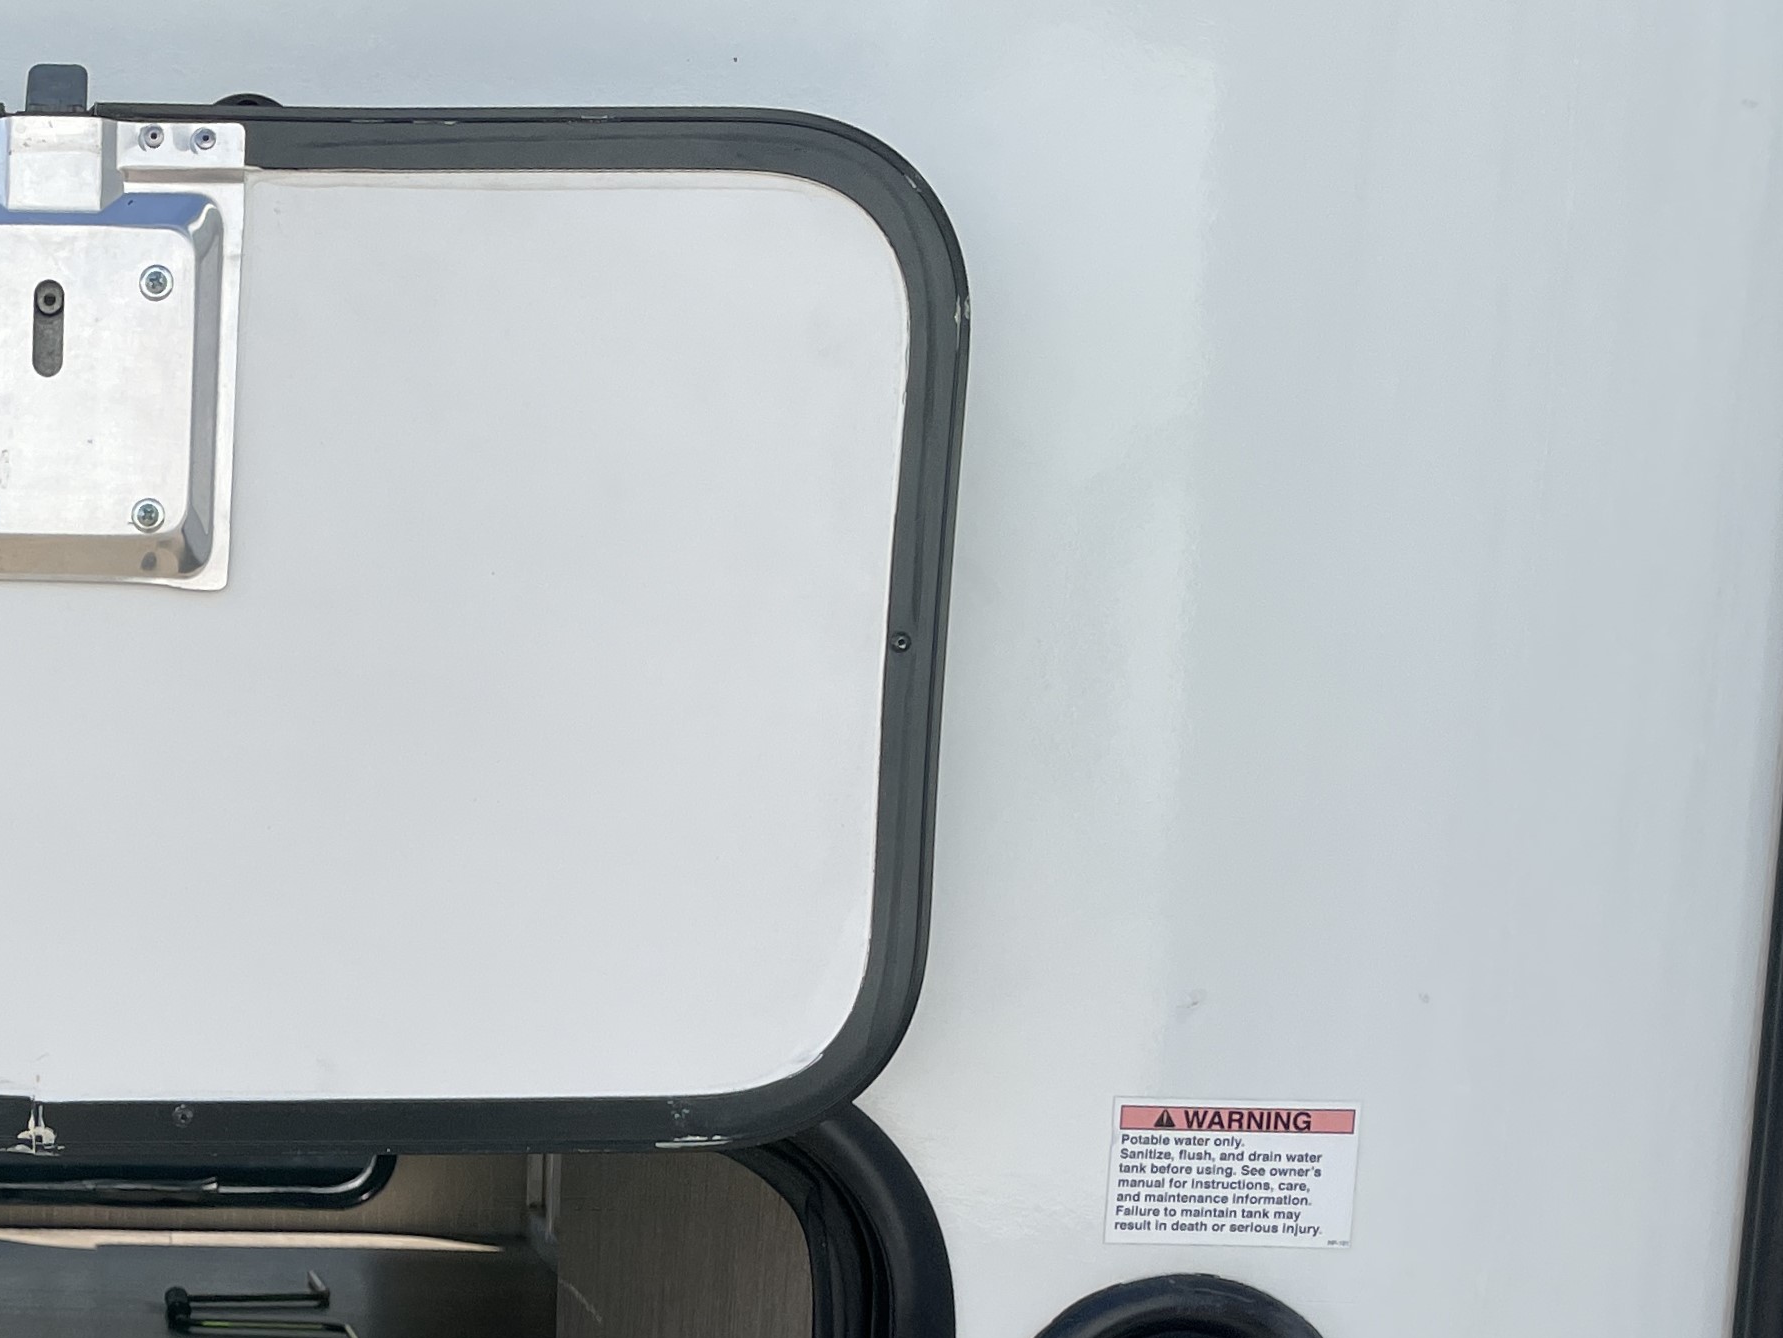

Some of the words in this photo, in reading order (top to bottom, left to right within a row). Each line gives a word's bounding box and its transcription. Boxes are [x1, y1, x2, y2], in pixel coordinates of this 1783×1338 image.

[1184, 1110, 1312, 1131] WARNING
[1121, 1134, 1169, 1146] Potable
[1174, 1135, 1209, 1147] water
[1213, 1136, 1245, 1148] only.
[1120, 1148, 1174, 1161] Sanitize,
[1178, 1150, 1215, 1162] flush,
[1219, 1151, 1244, 1162] and
[1248, 1151, 1281, 1163] drain
[1286, 1152, 1322, 1163] water
[1119, 1163, 1146, 1174] tank
[1150, 1164, 1192, 1175] before
[1196, 1164, 1236, 1175] using.
[1240, 1165, 1265, 1176] See
[1269, 1166, 1322, 1177] owner's
[1117, 1178, 1164, 1189] manual
[1168, 1179, 1186, 1189] for
[1191, 1179, 1273, 1191] instructions,
[1278, 1181, 1310, 1192] care,
[1117, 1192, 1140, 1202] and
[1144, 1192, 1228, 1204] maintenance
[1232, 1193, 1312, 1206] information.
[1115, 1206, 1159, 1218] Failure
[1163, 1207, 1176, 1218] to
[1180, 1207, 1237, 1220] maintain
[1241, 1209, 1269, 1221] tank
[1273, 1209, 1301, 1222] may
[1114, 1220, 1150, 1231] result
[1154, 1221, 1166, 1232] in
[1171, 1221, 1207, 1233] death
[1211, 1222, 1224, 1233] or
[1229, 1222, 1278, 1235] serious
[1282, 1223, 1322, 1236] injury.
